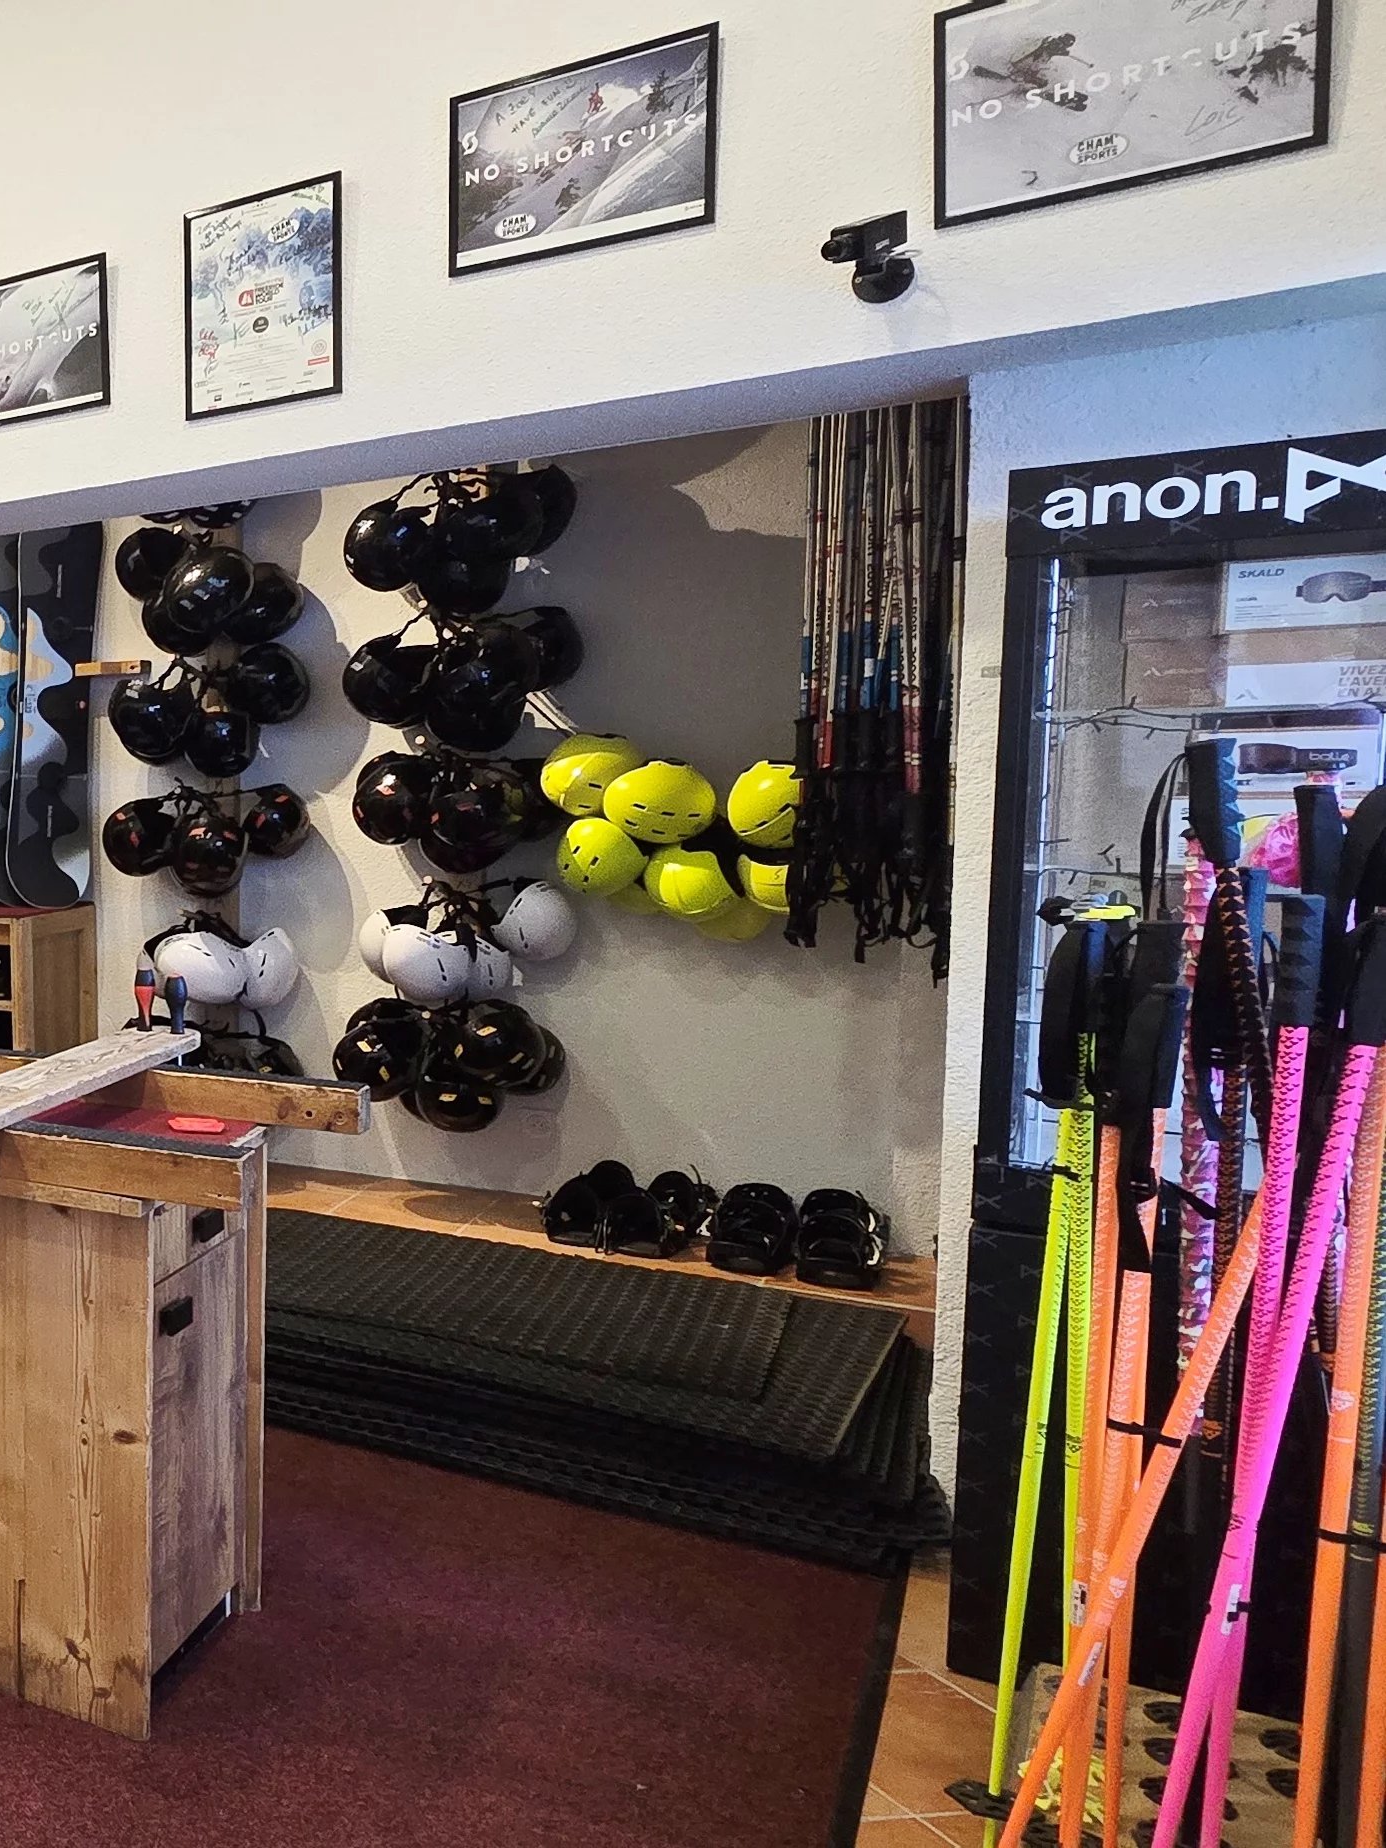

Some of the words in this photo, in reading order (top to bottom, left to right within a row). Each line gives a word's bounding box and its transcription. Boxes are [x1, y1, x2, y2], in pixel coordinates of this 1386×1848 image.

[952, 99, 1002, 127] NO
[465, 164, 500, 187] NO
[517, 113, 697, 173] SHORTCUTS
[1238, 568, 1285, 579] SKALD
